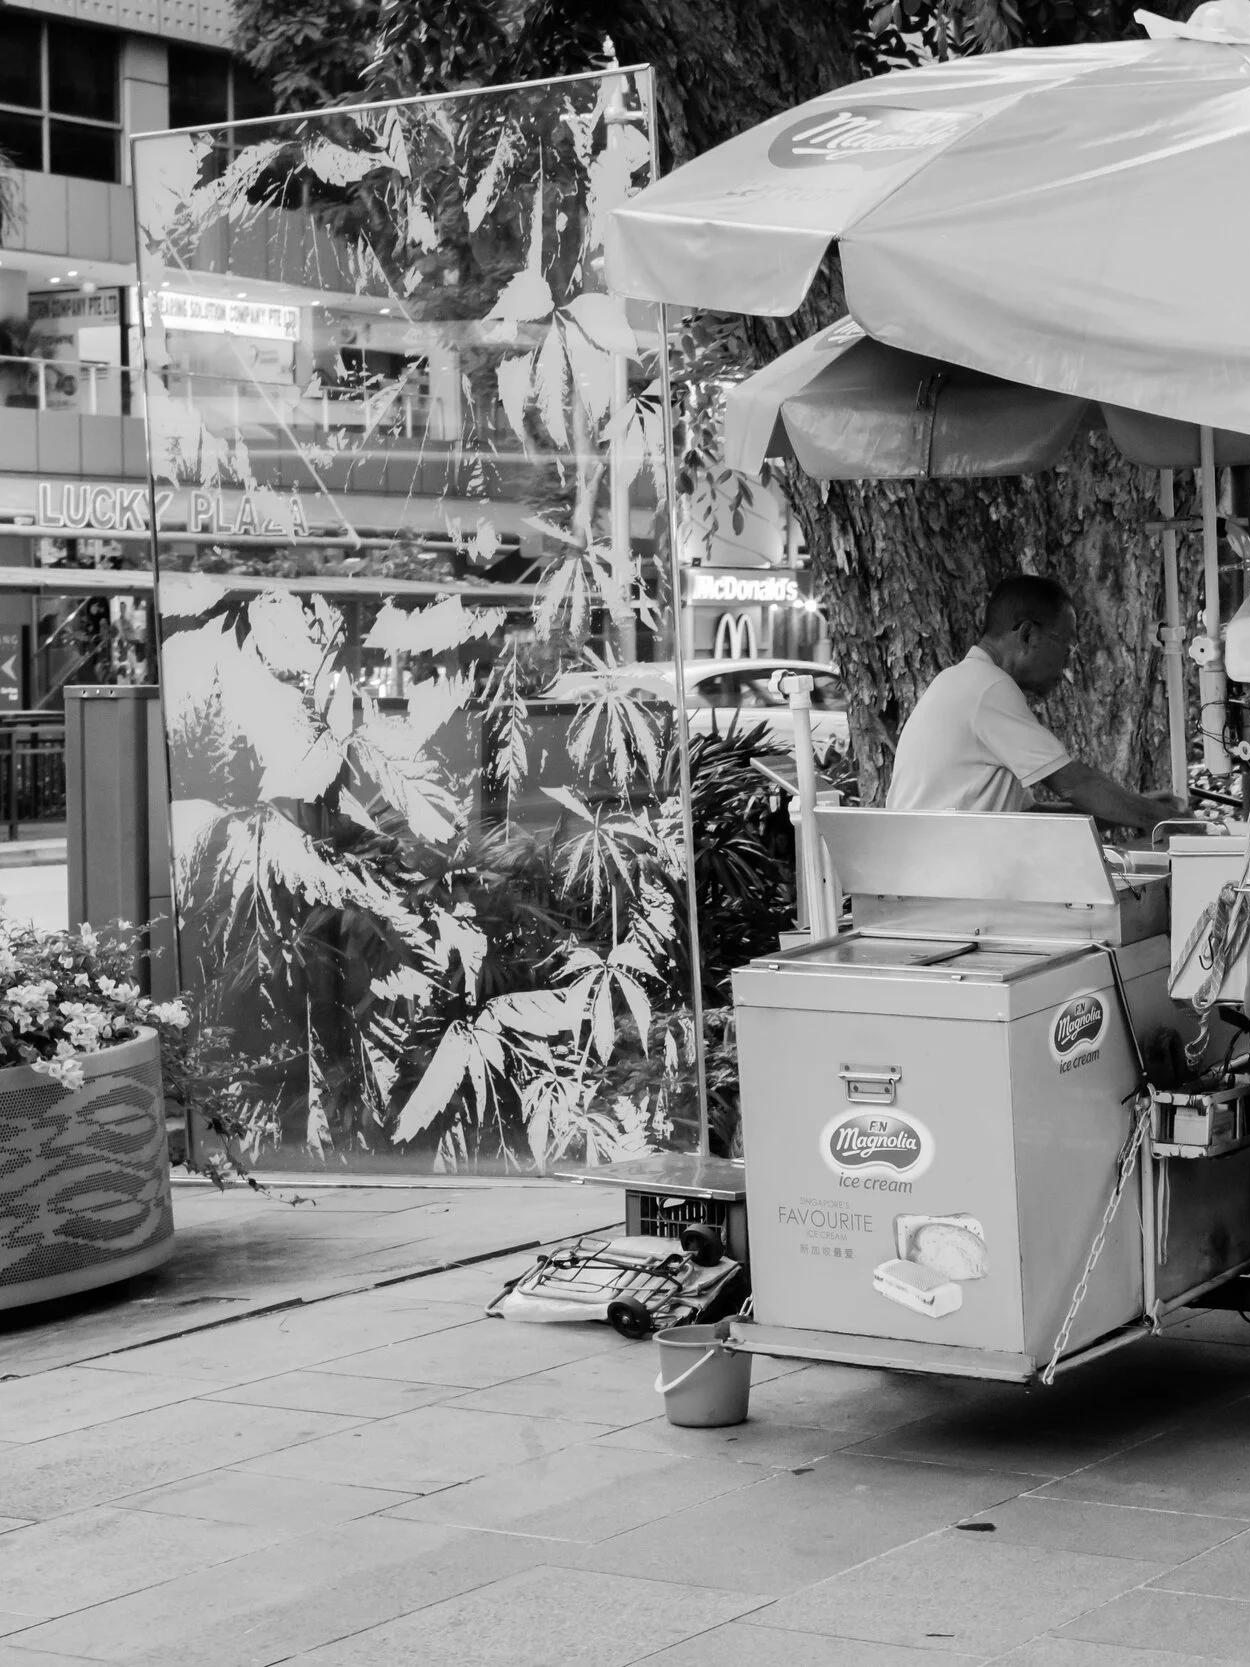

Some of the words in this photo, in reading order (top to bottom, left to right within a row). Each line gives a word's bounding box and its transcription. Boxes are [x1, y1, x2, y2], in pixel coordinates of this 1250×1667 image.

[38, 483, 174, 531] LUCKY
[1057, 1006, 1102, 1045] Magnolia
[1060, 1059, 1072, 1075] ice
[1072, 1049, 1100, 1069] cream
[836, 1127, 918, 1158] Magnolia
[839, 1171, 860, 1189] ice
[863, 1177, 913, 1194] cream
[778, 1206, 873, 1233] FAVOURITE
